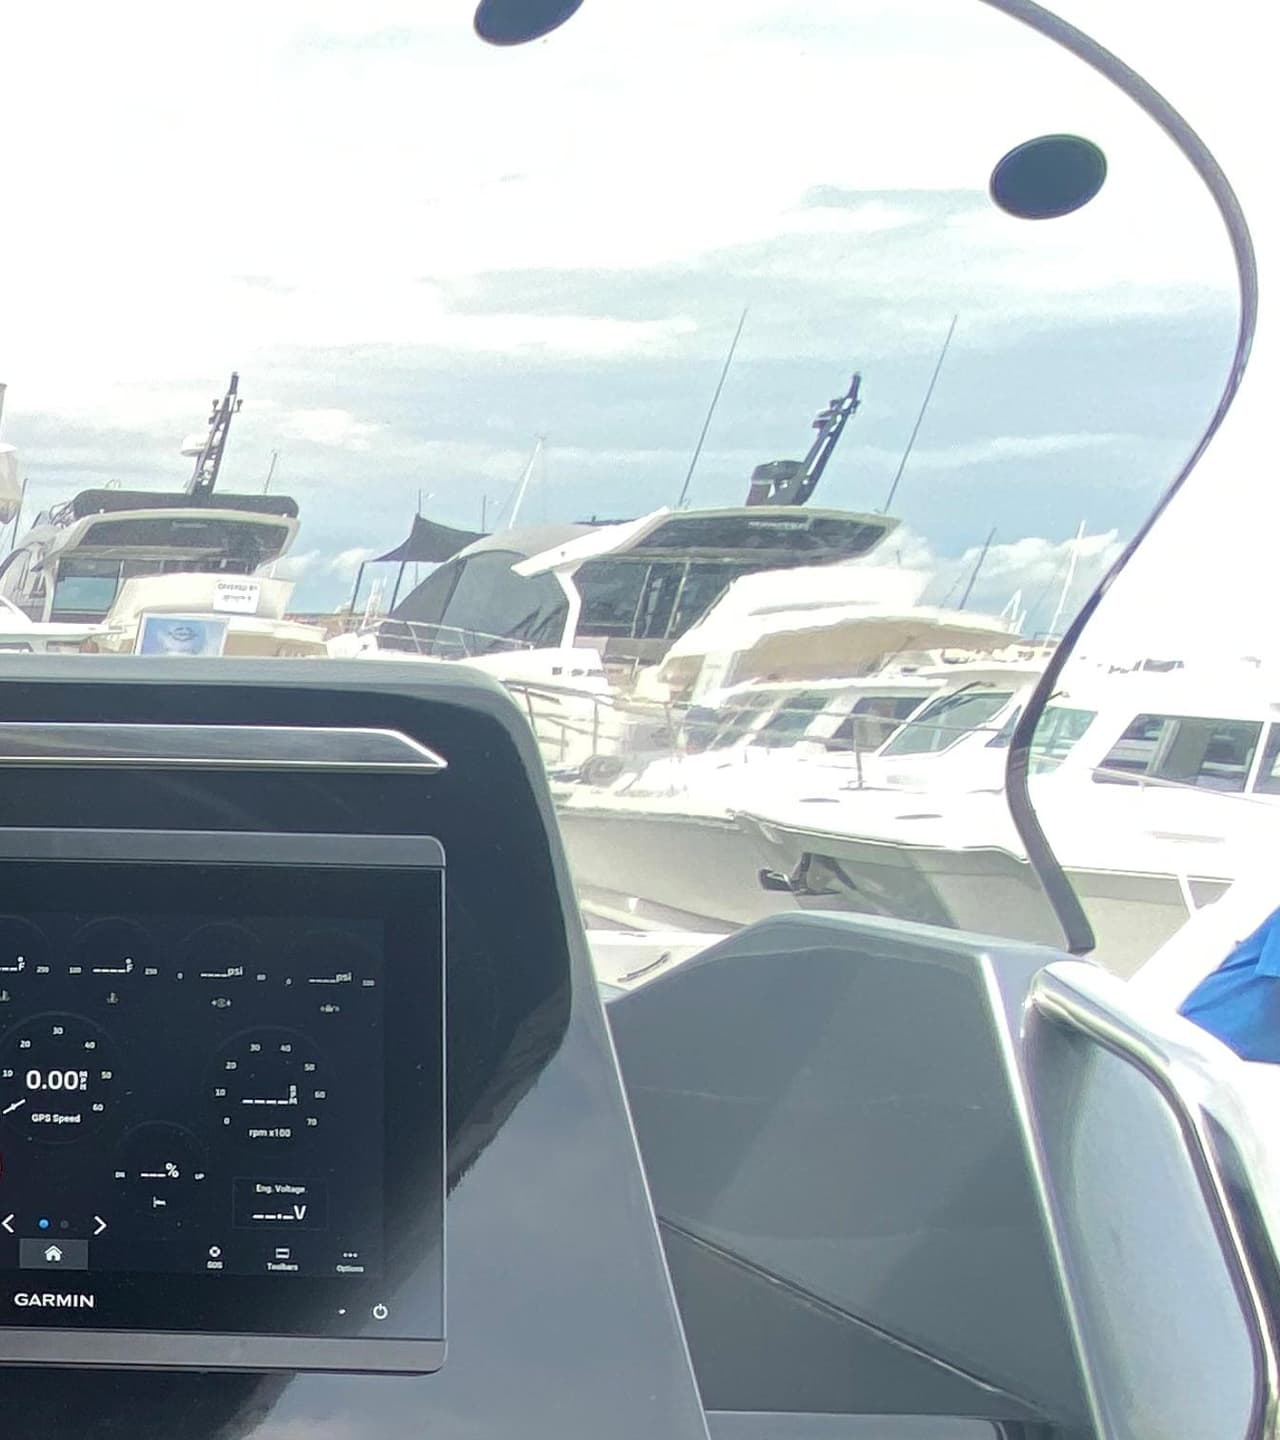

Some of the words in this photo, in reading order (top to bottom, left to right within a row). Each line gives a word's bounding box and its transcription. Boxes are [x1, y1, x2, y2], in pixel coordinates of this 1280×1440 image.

[227, 966, 244, 977] psi
[25, 1069, 79, 1091] 0.00
[31, 1113, 51, 1123] GPS
[52, 1113, 81, 1125] Speed
[13, 1292, 95, 1309] GARMIN
